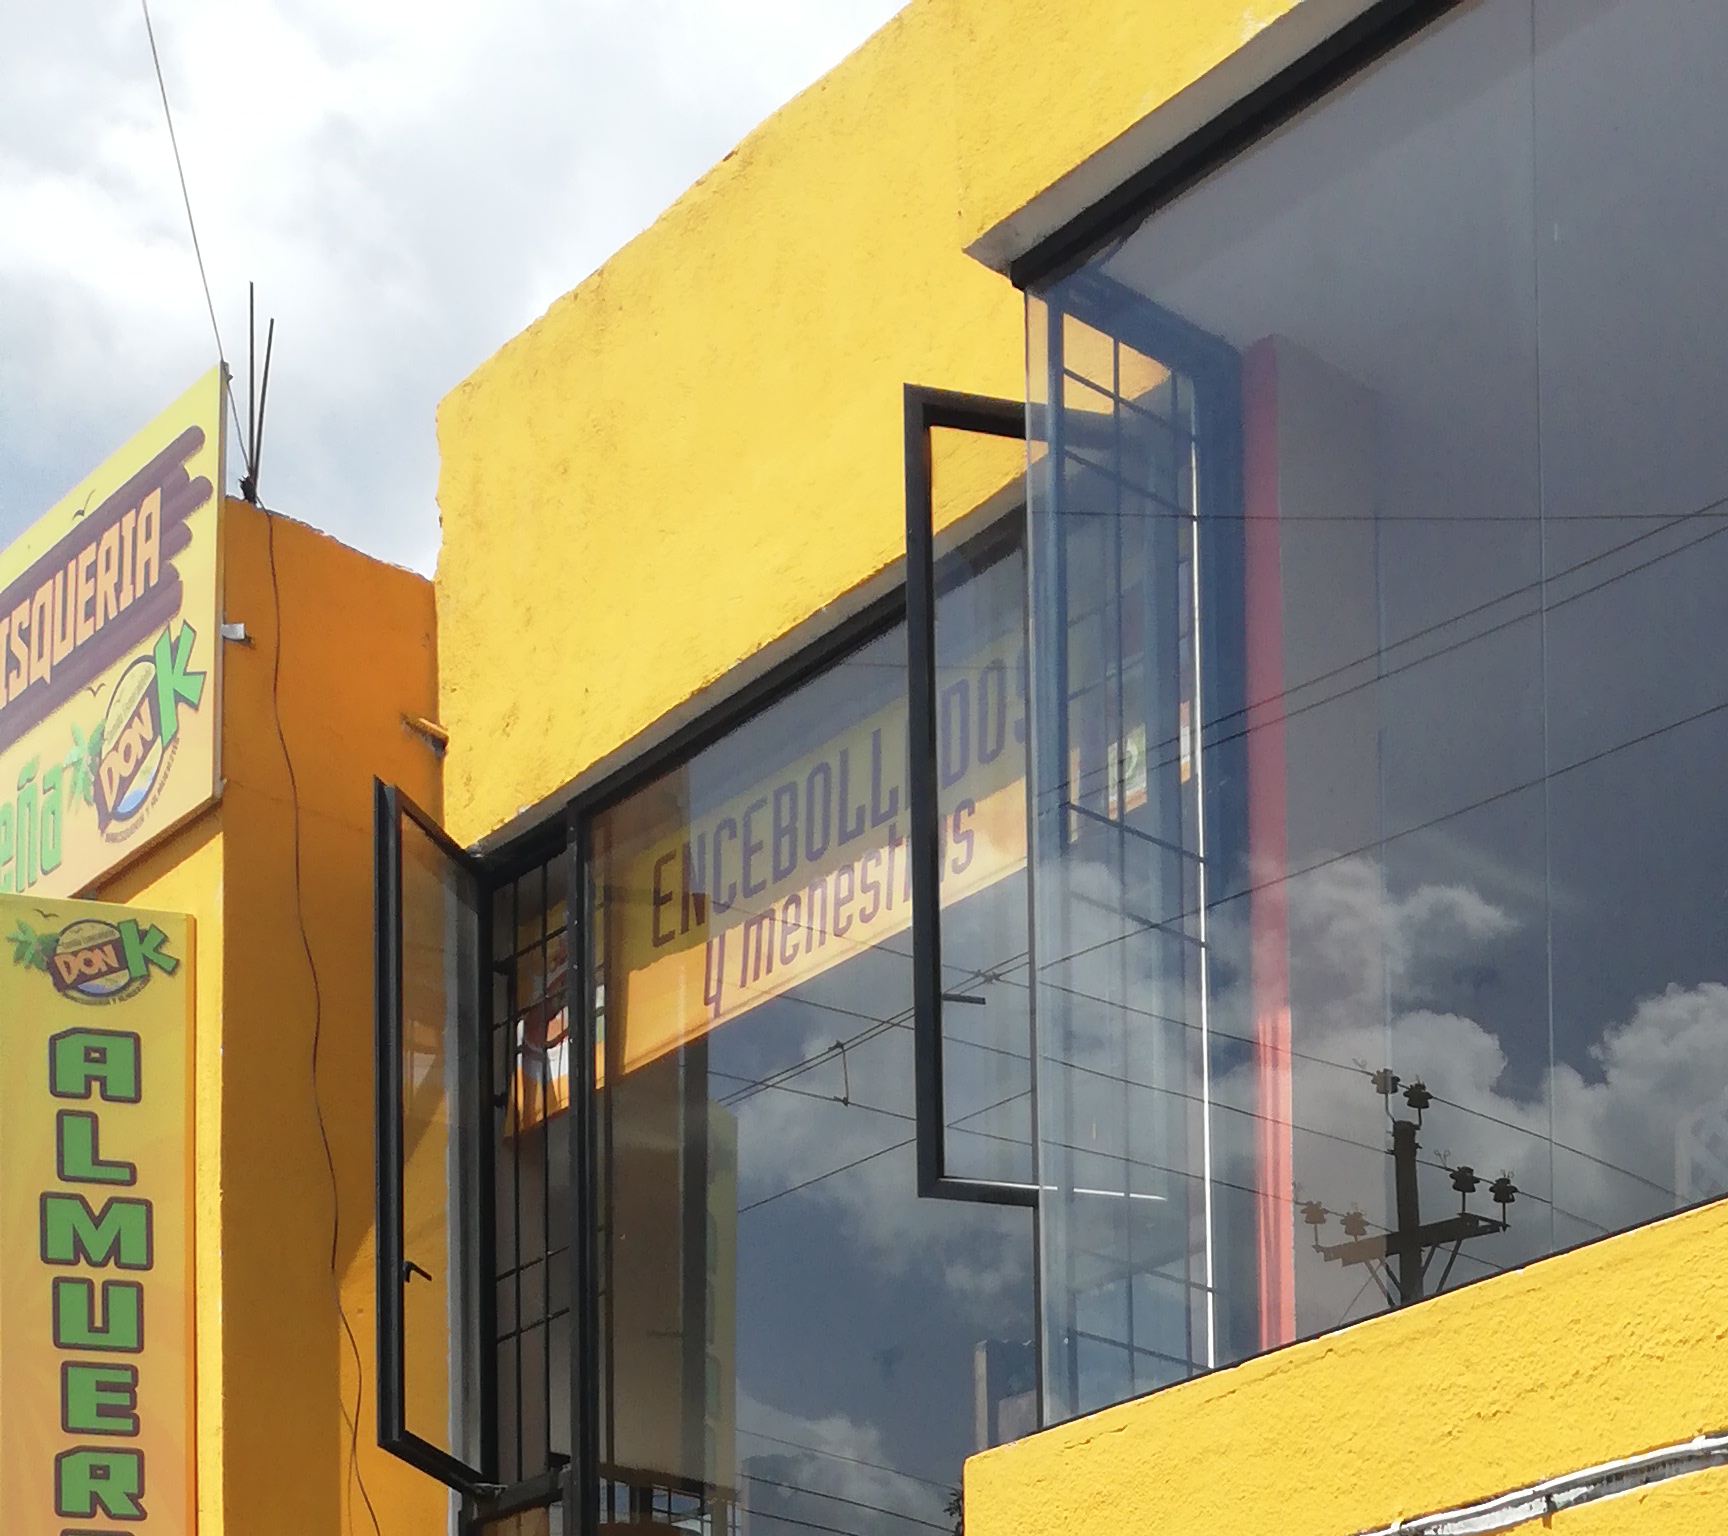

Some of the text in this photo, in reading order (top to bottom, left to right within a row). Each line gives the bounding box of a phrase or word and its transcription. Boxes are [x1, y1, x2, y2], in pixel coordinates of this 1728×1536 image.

[100, 697, 153, 812] DON
[153, 619, 207, 748] K
[651, 648, 1027, 948] ENCEBOLLDO
[54, 943, 120, 985] DON
[118, 918, 180, 978] K
